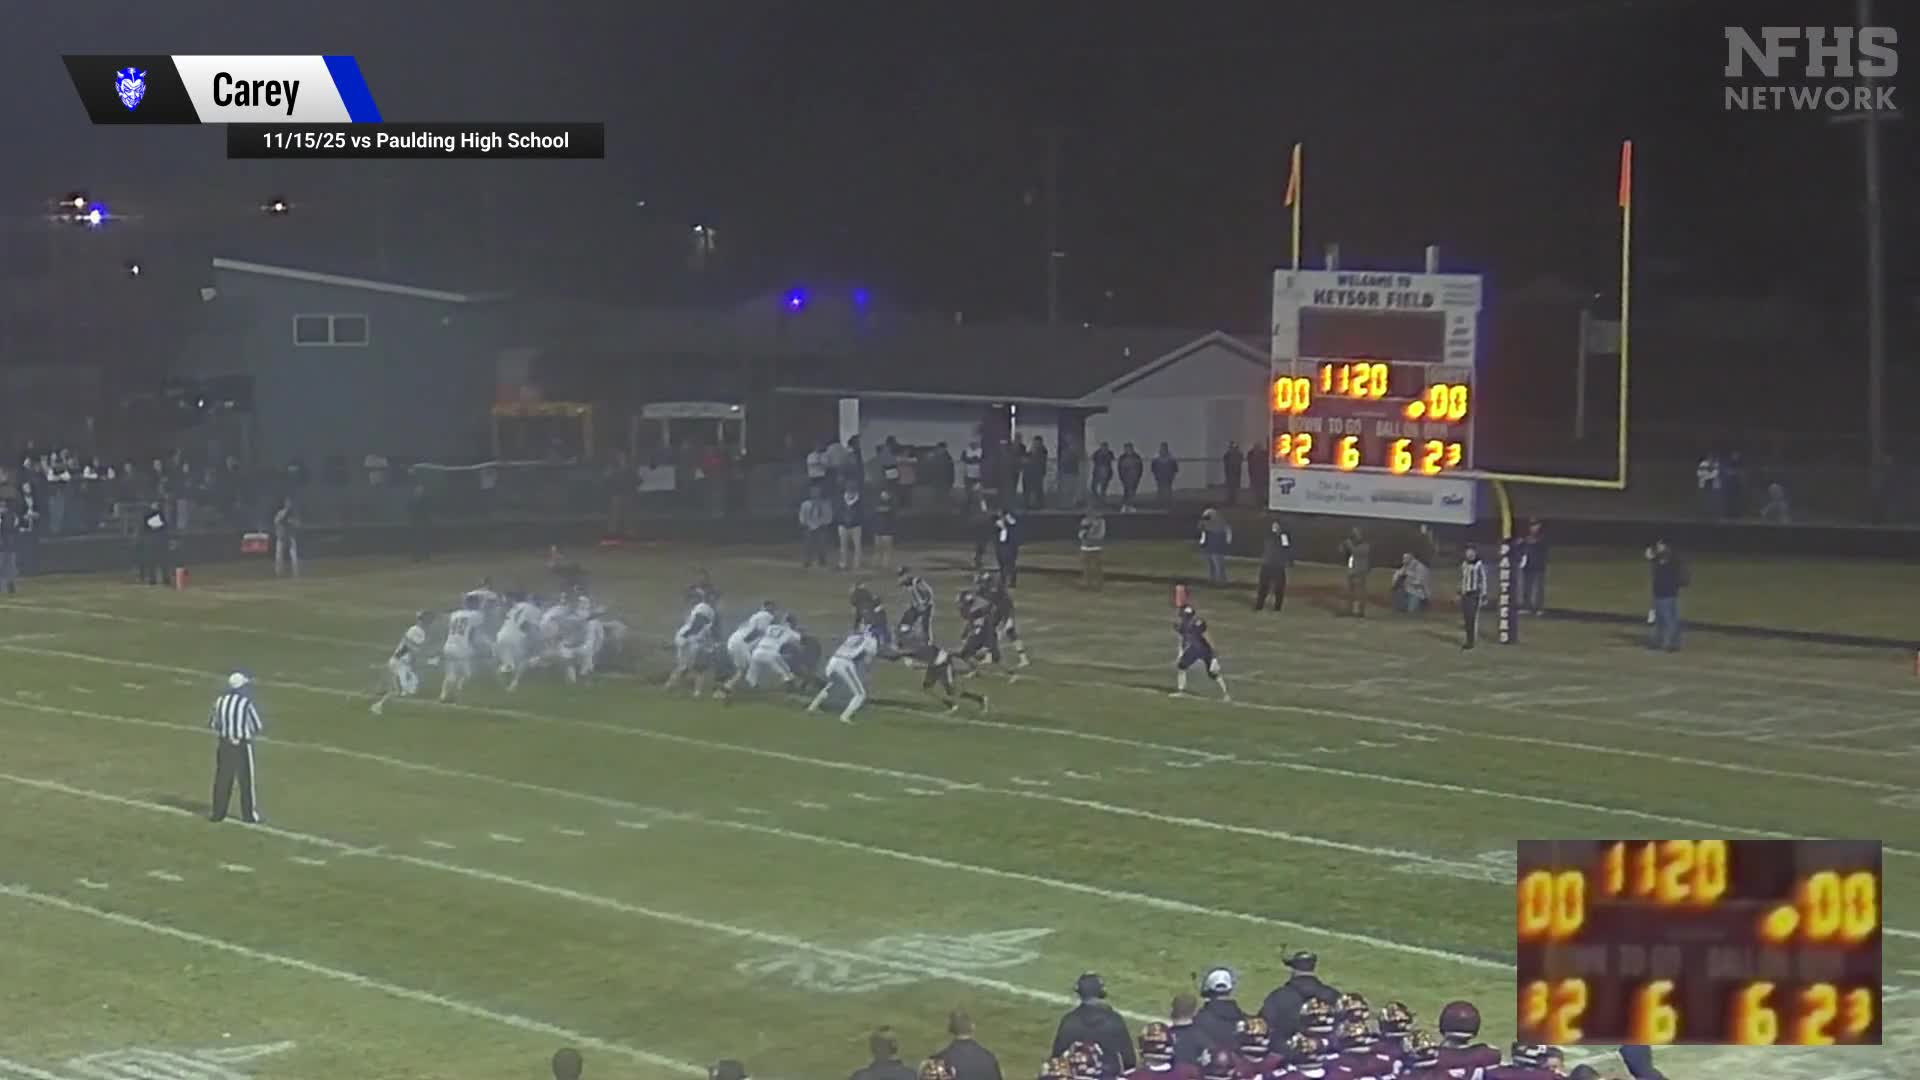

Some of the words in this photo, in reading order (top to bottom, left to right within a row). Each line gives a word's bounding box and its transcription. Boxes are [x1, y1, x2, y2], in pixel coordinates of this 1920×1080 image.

[1314, 288, 1379, 307] KEYSOR
[1386, 290, 1434, 308] FIELD
[1275, 377, 1312, 412] 00
[1340, 436, 1361, 470] 6
